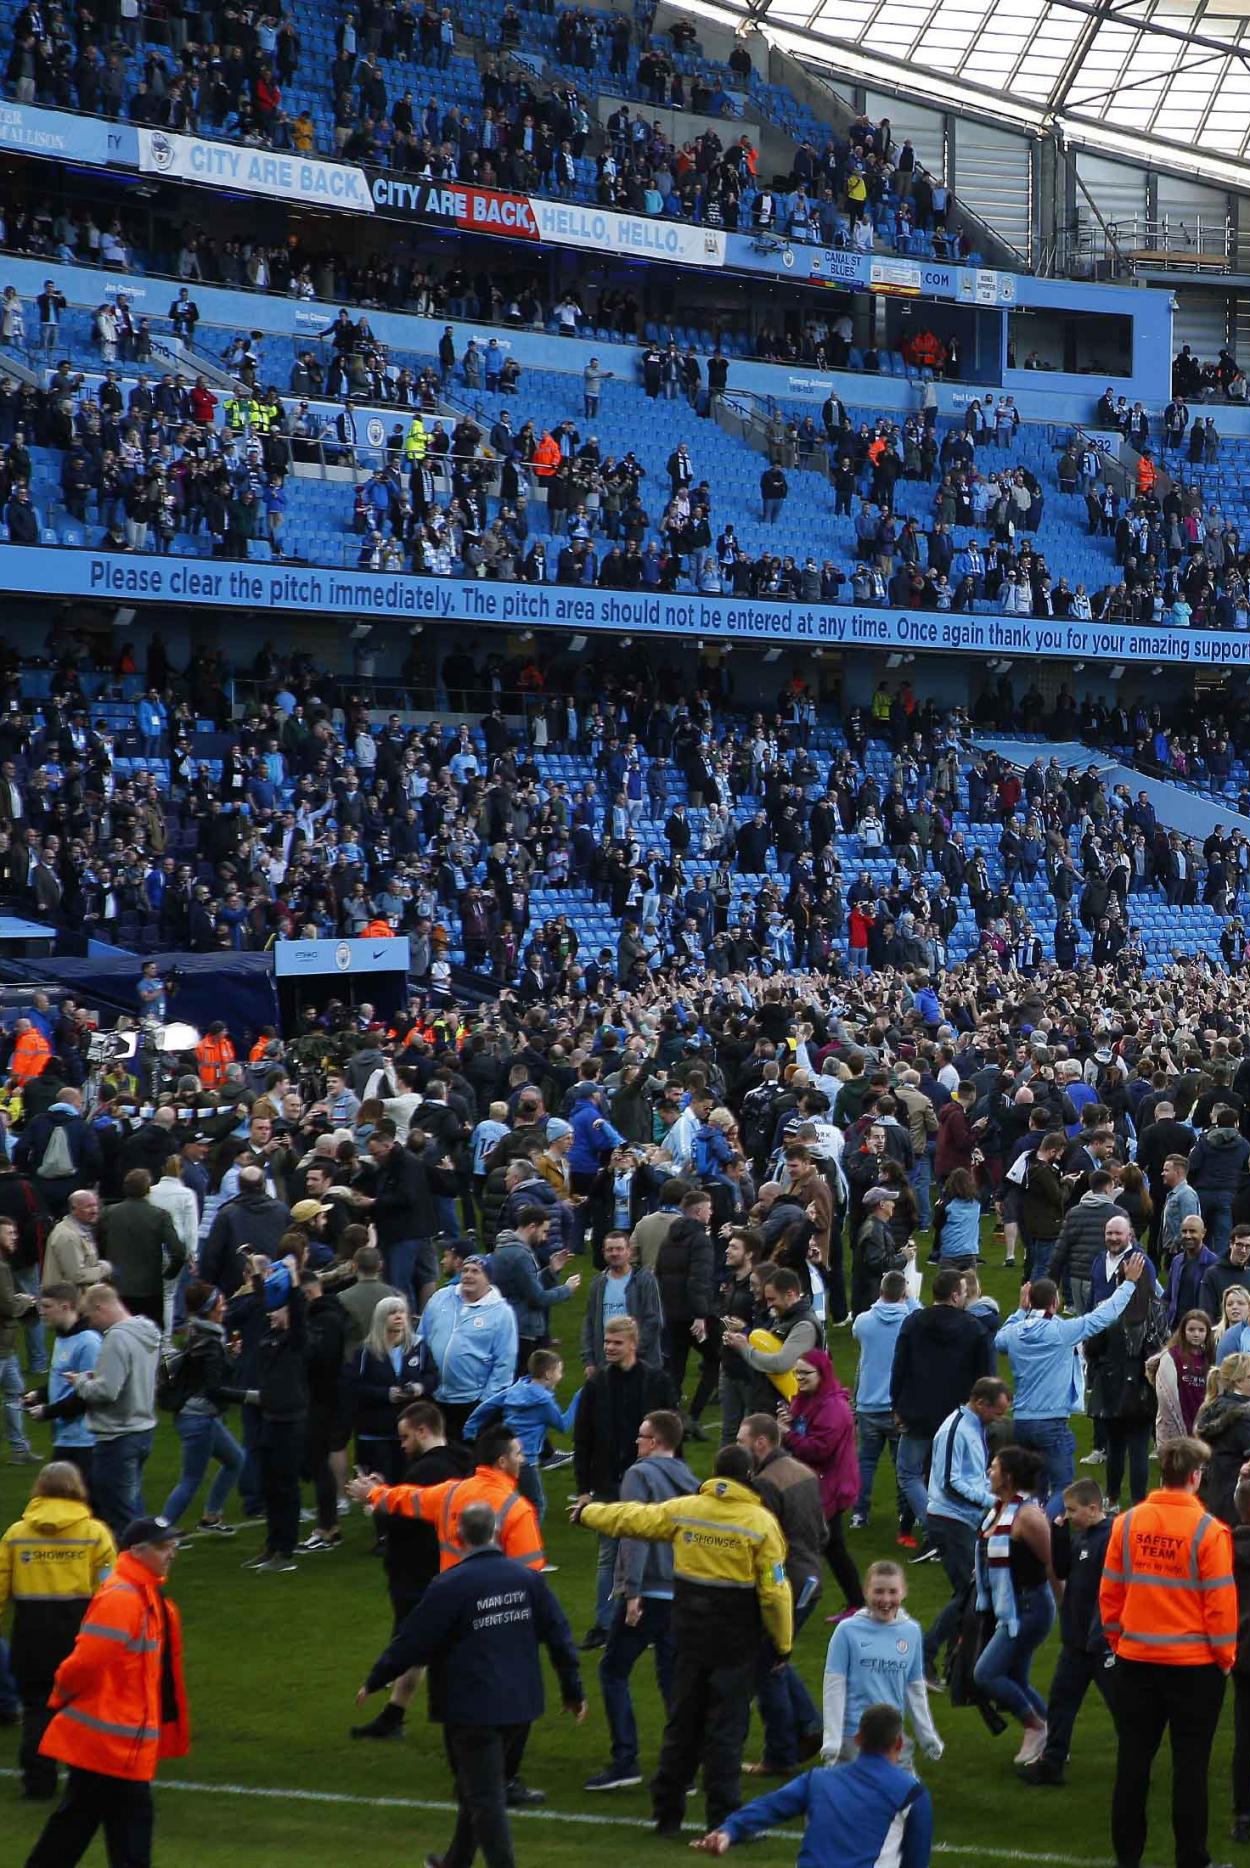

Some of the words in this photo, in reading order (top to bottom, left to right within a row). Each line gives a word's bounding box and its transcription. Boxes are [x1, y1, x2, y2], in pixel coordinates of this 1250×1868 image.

[190, 145, 240, 177] CITY
[247, 156, 292, 188] ARE
[300, 165, 365, 204] BACK,
[373, 178, 418, 209] CITY
[425, 187, 467, 218] ARE
[473, 195, 535, 234] BACK,
[542, 208, 612, 245] HELLO,
[618, 221, 684, 254] HELLO.
[825, 251, 850, 265] CANAL
[851, 256, 862, 267] ST
[831, 263, 855, 277] BLUES
[90, 561, 162, 592] Please
[170, 567, 222, 596] clear
[229, 570, 262, 599] the
[270, 576, 322, 605] pitch
[329, 582, 455, 616] immediately.
[462, 587, 496, 614] The
[503, 592, 549, 620] pitch
[556, 600, 594, 620] area
[601, 598, 659, 624] should
[666, 604, 694, 626] not
[700, 604, 722, 628] be
[727, 608, 792, 632] entered
[797, 612, 813, 634] at
[818, 617, 846, 640] any
[852, 616, 890, 638] time.
[897, 618, 937, 641] Once
[943, 625, 983, 647] again
[989, 622, 1030, 646] thank
[1036, 632, 1062, 652] you
[1067, 628, 1088, 650] for
[1093, 634, 1125, 654] your
[1130, 634, 1190, 659] amazing
[1136, 1533, 1185, 1549] SAFETY
[32, 1550, 85, 1561] SHOWSEC
[1142, 1546, 1176, 1561] TEAM
[476, 1597, 502, 1611] MAN
[502, 1591, 526, 1605] CITY
[473, 1612, 503, 1630] EVENT
